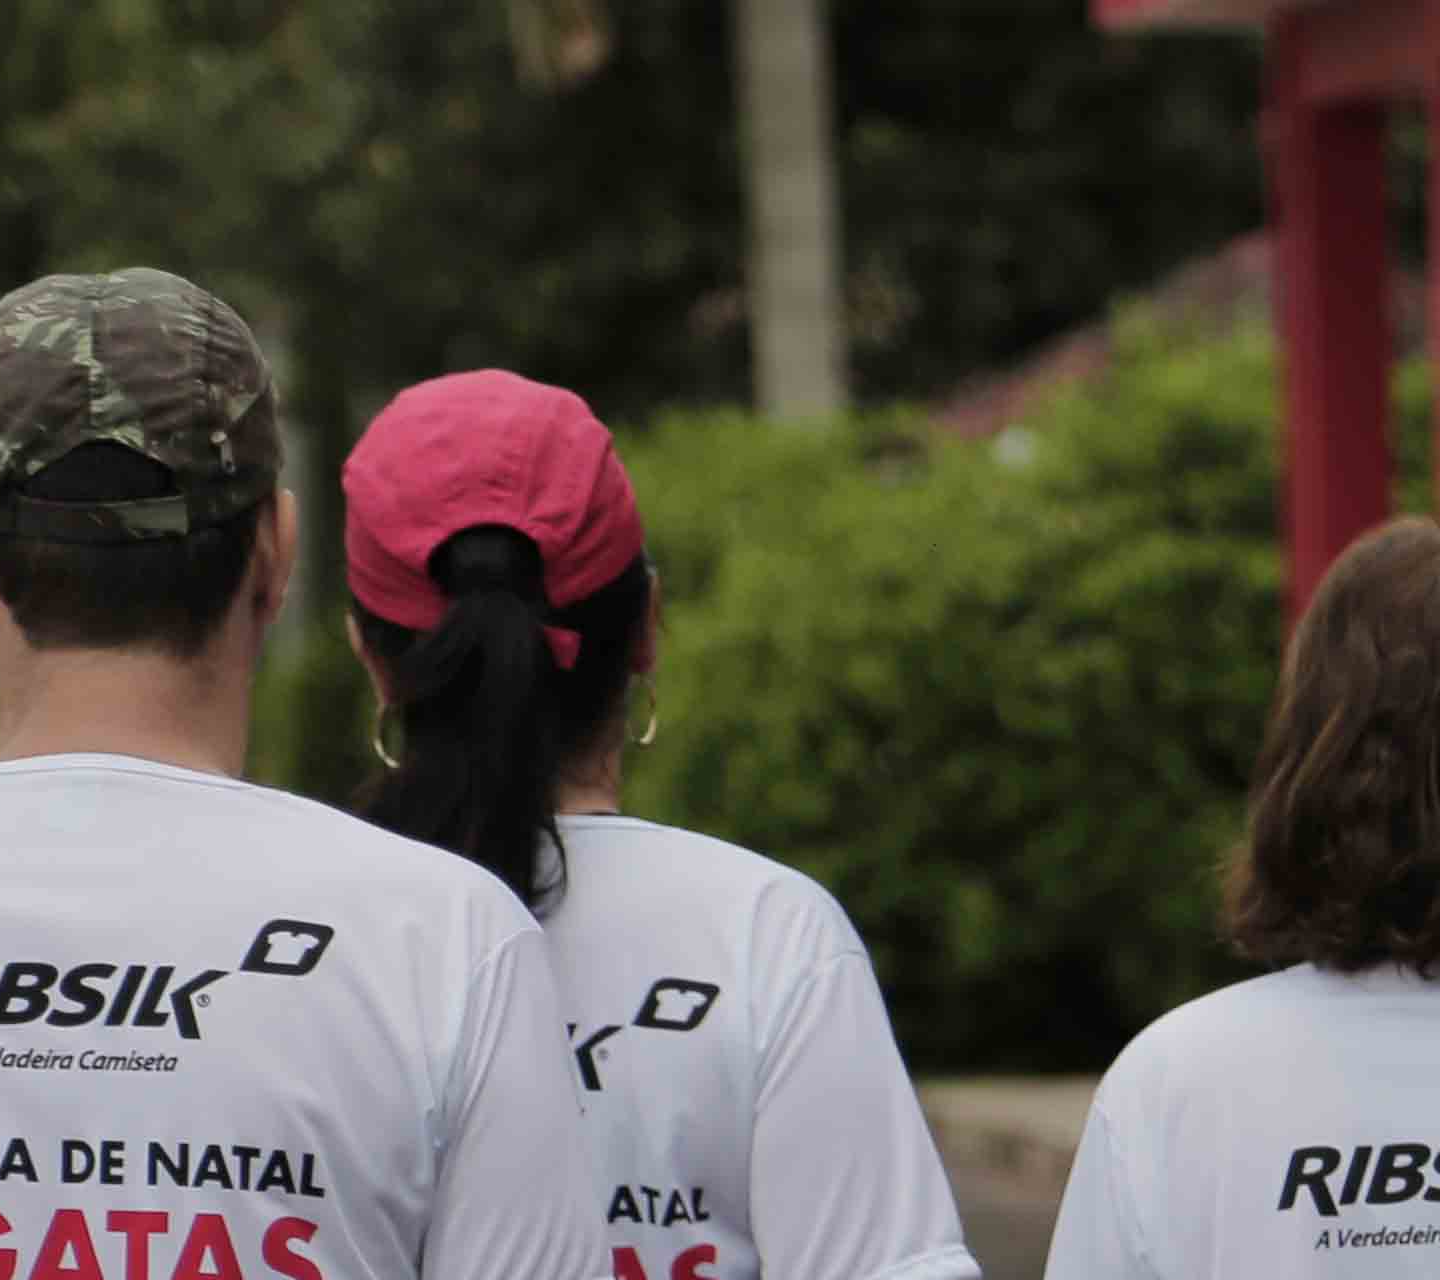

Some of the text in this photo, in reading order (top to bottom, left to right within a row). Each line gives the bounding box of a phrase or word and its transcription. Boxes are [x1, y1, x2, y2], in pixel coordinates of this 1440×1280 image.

[78, 1049, 178, 1073] Camiseta
[61, 1139, 125, 1185] DE
[147, 1141, 326, 1198] NATAL
[607, 1185, 710, 1227] ATAL
[1315, 1230, 1331, 1251] A
